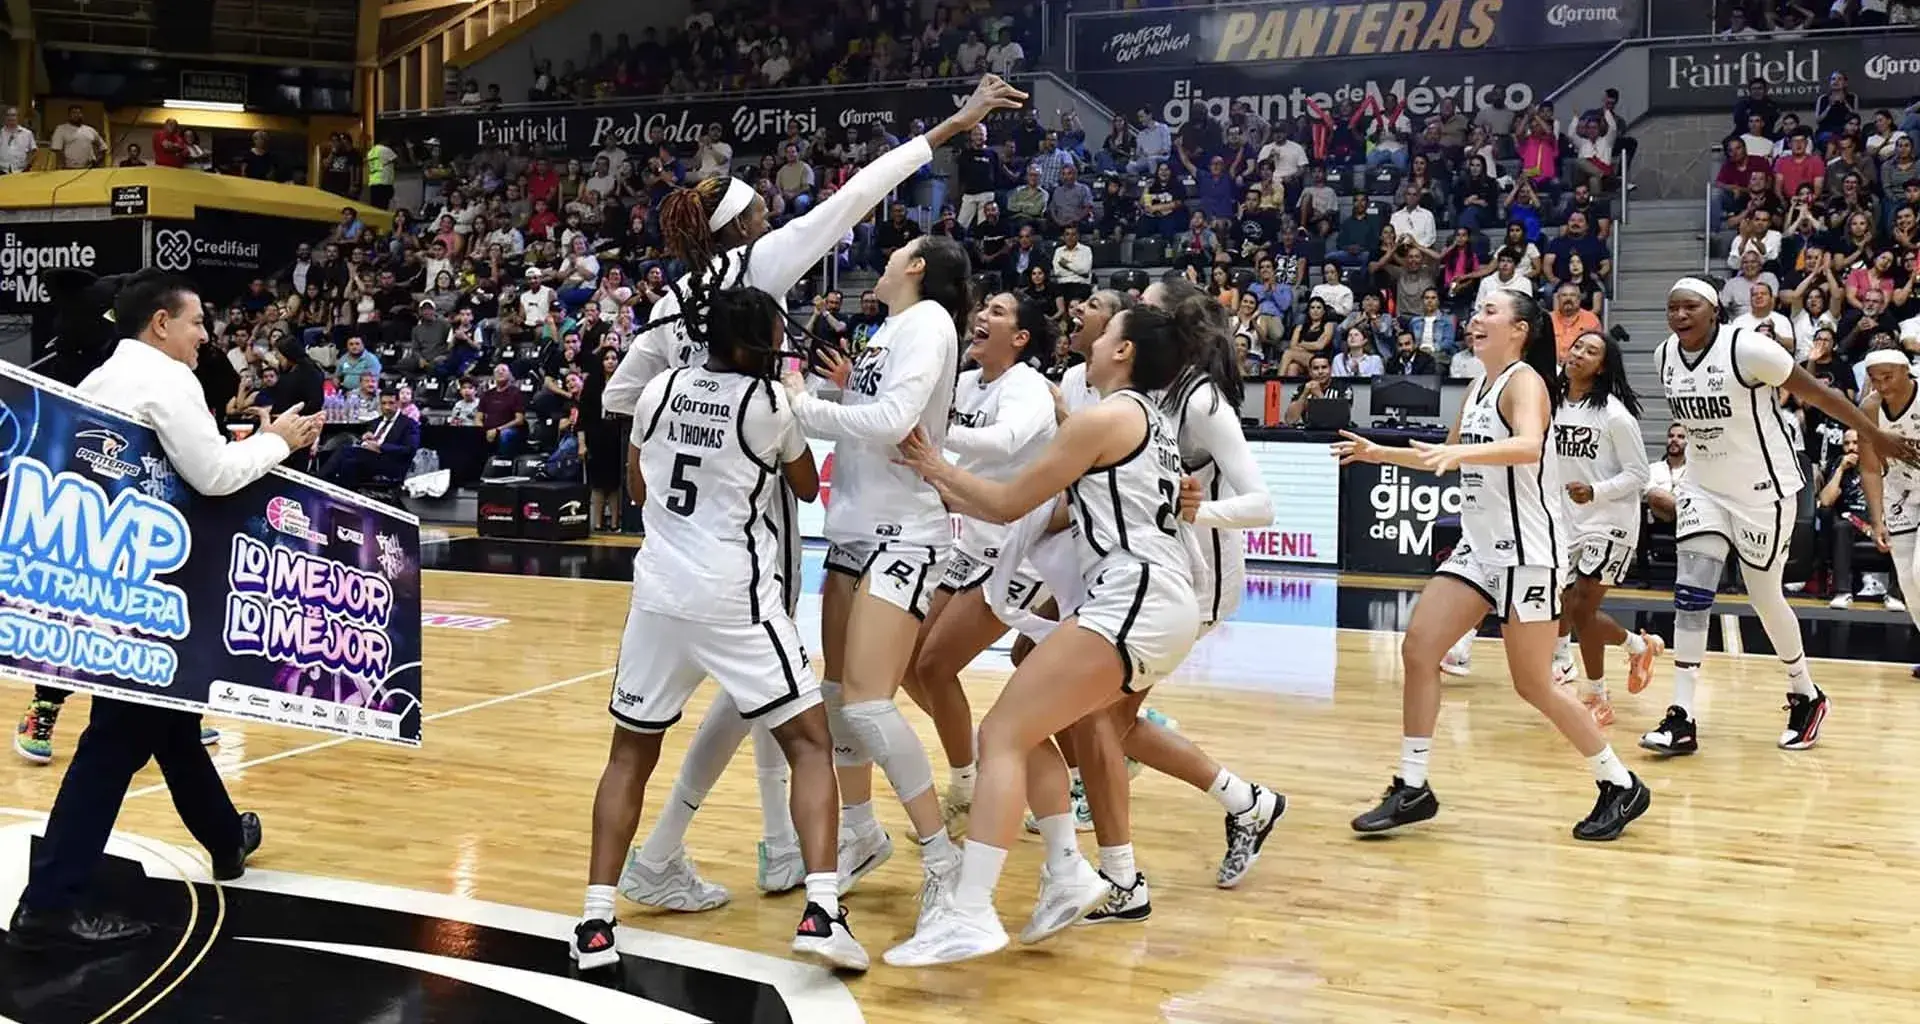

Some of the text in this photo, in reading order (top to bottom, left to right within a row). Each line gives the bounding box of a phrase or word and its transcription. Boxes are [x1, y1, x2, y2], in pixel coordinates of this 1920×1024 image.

[1547, 4, 1621, 27] Corona
[1214, 0, 1504, 63] PANTERAS
[1116, 46, 1145, 63] QUE
[1668, 49, 1820, 89] Fairfield
[1173, 81, 1190, 97] El
[1335, 88, 1364, 102] de
[1767, 85, 1821, 96] ARRIOTT
[759, 107, 817, 135] Fitsi
[5, 233, 16, 247] El
[194, 238, 258, 257] Credifácil
[0, 241, 96, 275] gigante
[0, 276, 17, 291] de
[670, 393, 731, 419] Corona
[680, 423, 725, 449] THOMAS
[666, 453, 702, 517] 5
[1380, 465, 1398, 484] El
[3, 463, 186, 580] MVP
[1369, 520, 1398, 539] de
[1243, 531, 1318, 557] MENIL
[0, 549, 184, 628] EXTRANJERA
[232, 537, 268, 590] LO
[272, 548, 390, 626] MEJOR
[226, 596, 388, 680] LO MEJOR
[72, 630, 174, 684] NDOUR
